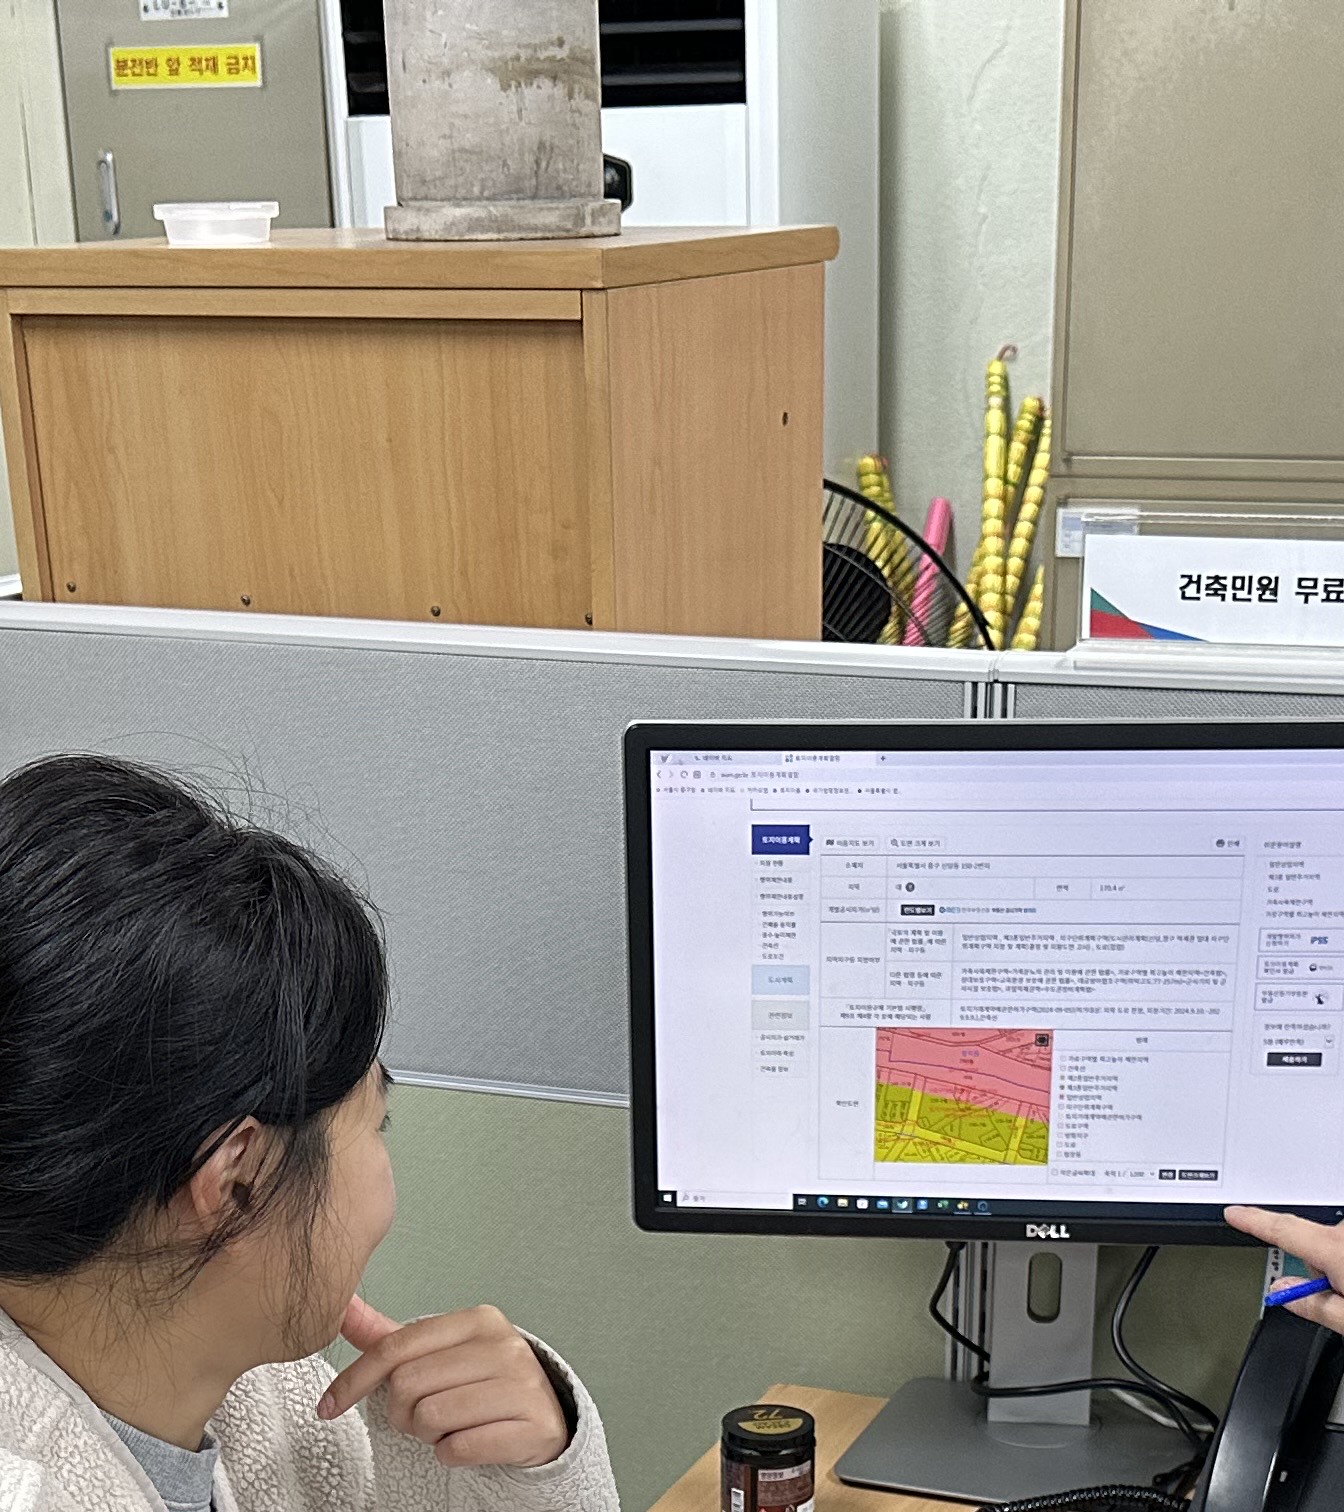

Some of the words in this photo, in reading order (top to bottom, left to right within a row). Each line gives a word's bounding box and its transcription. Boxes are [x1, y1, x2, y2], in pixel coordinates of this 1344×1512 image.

[226, 55, 256, 75] 금지
[1179, 574, 1280, 603] 건축민원
[1026, 1223, 1070, 1239] DELL
